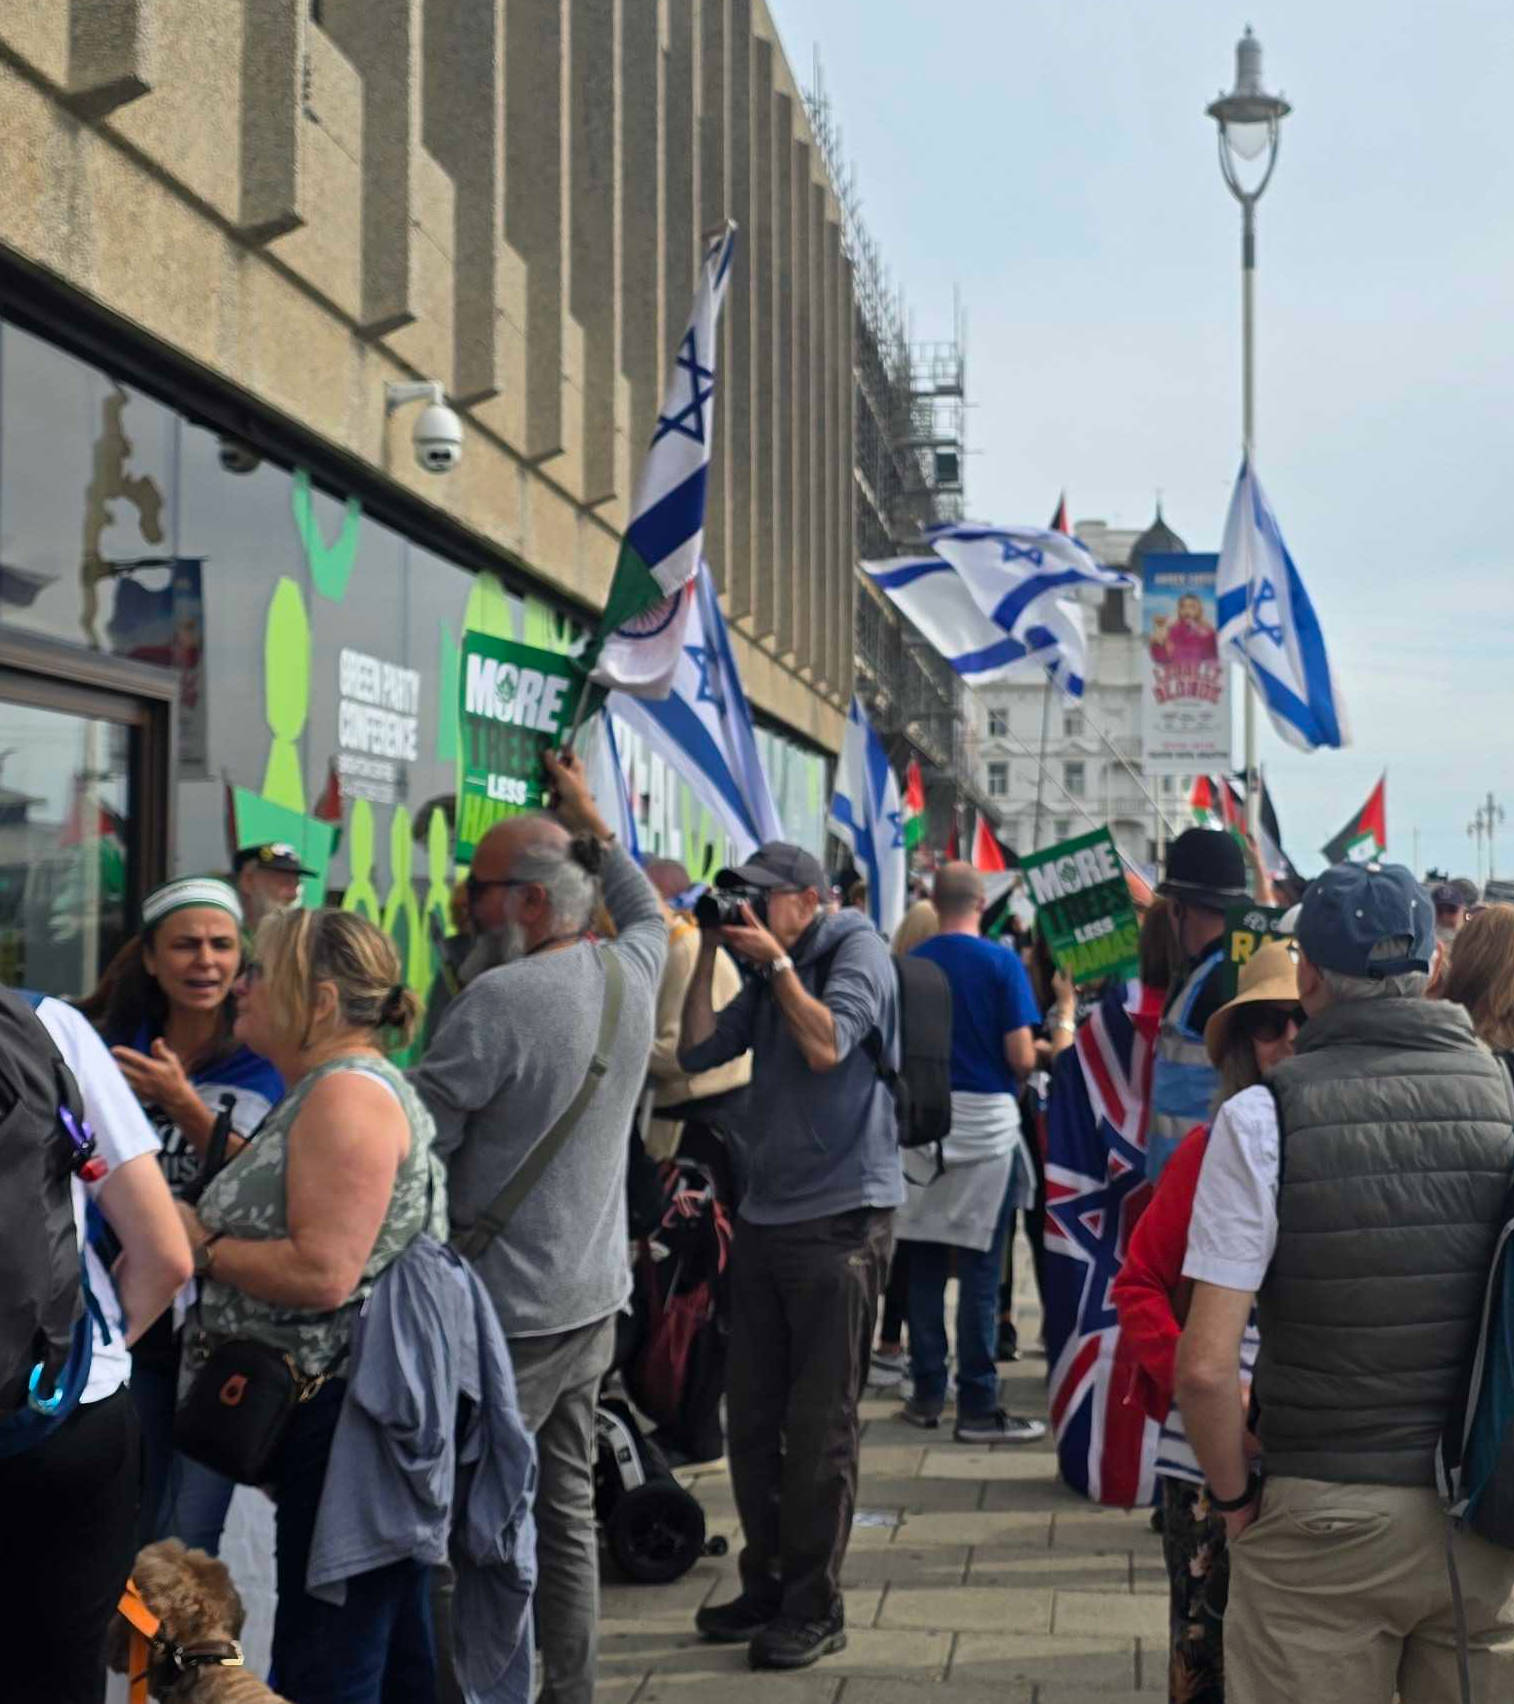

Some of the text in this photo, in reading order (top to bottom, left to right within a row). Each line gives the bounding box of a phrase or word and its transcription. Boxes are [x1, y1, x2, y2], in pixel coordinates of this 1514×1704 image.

[465, 652, 570, 734] MORE
[486, 772, 527, 806] LESS
[1027, 841, 1120, 905] MORE
[1056, 923, 1138, 976] HAMAS
[1074, 915, 1115, 944] LESS
